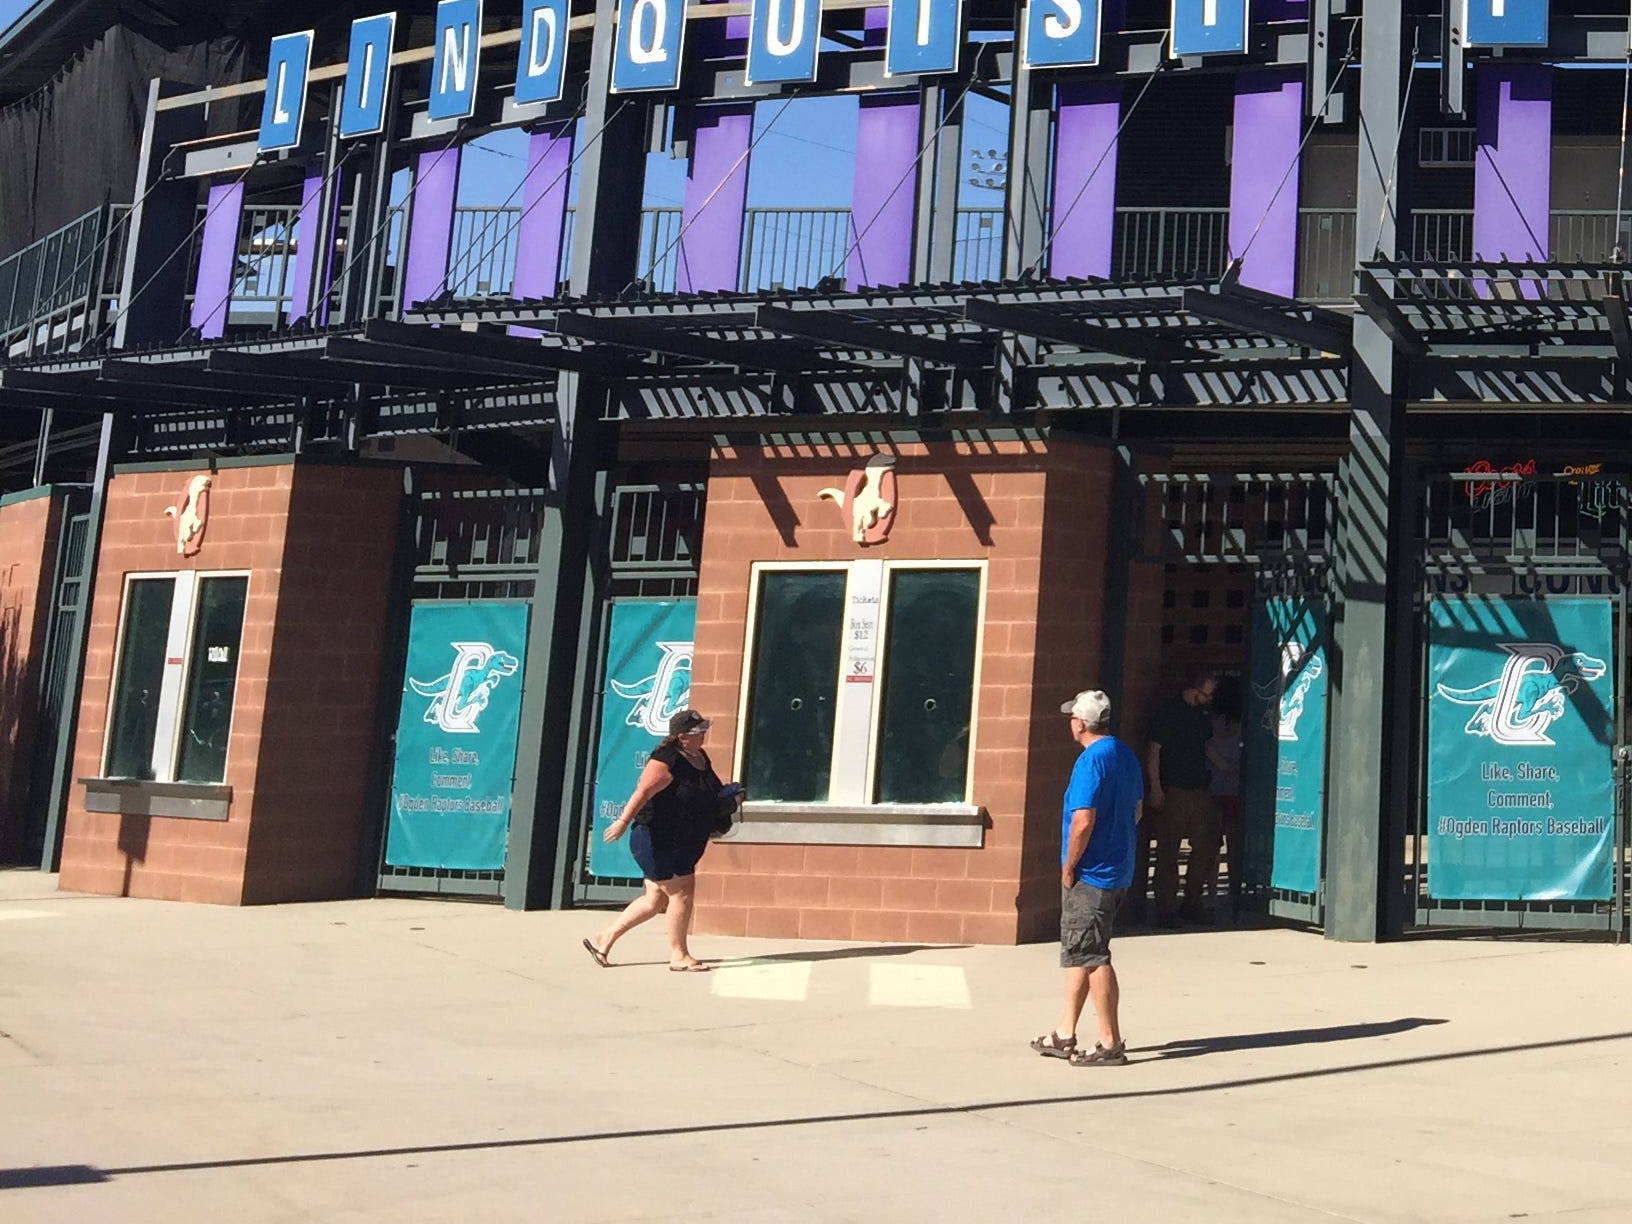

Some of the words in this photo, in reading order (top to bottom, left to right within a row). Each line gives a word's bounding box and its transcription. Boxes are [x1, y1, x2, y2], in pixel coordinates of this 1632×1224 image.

[854, 630, 869, 640] $12
[853, 661, 869, 675] $6
[1481, 762, 1513, 781] Like,
[1517, 762, 1560, 782] Share,
[1488, 789, 1554, 809] Comment,
[1438, 816, 1488, 840] #Ogden
[1492, 816, 1543, 839] Raptors
[1546, 816, 1604, 836] Baseball
